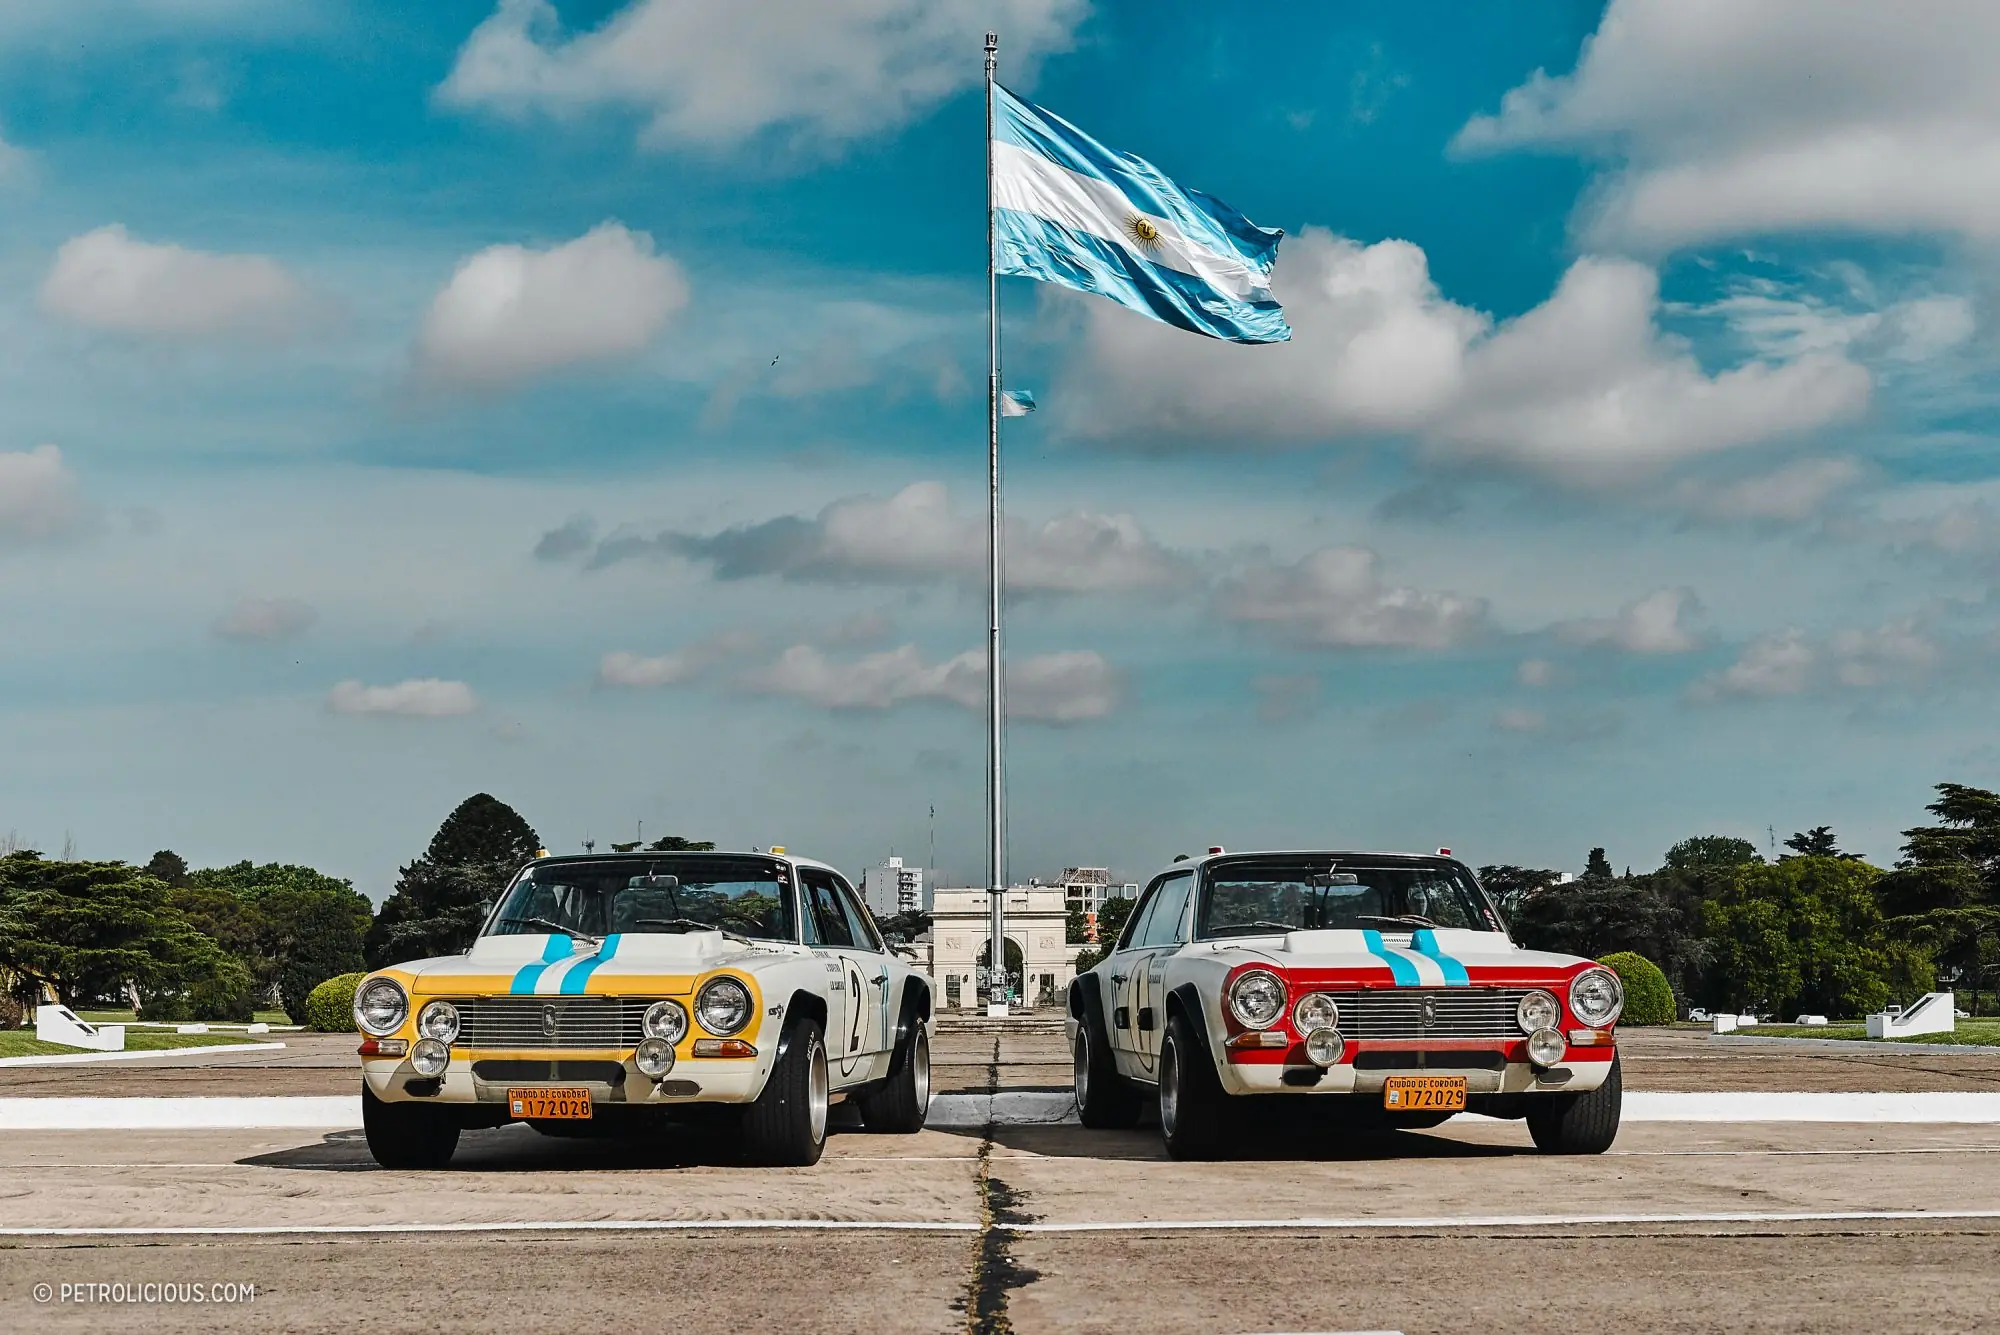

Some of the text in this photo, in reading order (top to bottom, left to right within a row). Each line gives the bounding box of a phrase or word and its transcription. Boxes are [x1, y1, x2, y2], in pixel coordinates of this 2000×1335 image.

[850, 970, 861, 1052] 2
[1389, 1079, 1463, 1088] CIUDAD DE CORDOBA
[511, 1090, 587, 1099] CIUDAD DE CORDOBA
[1405, 1090, 1464, 1106] 172.029
